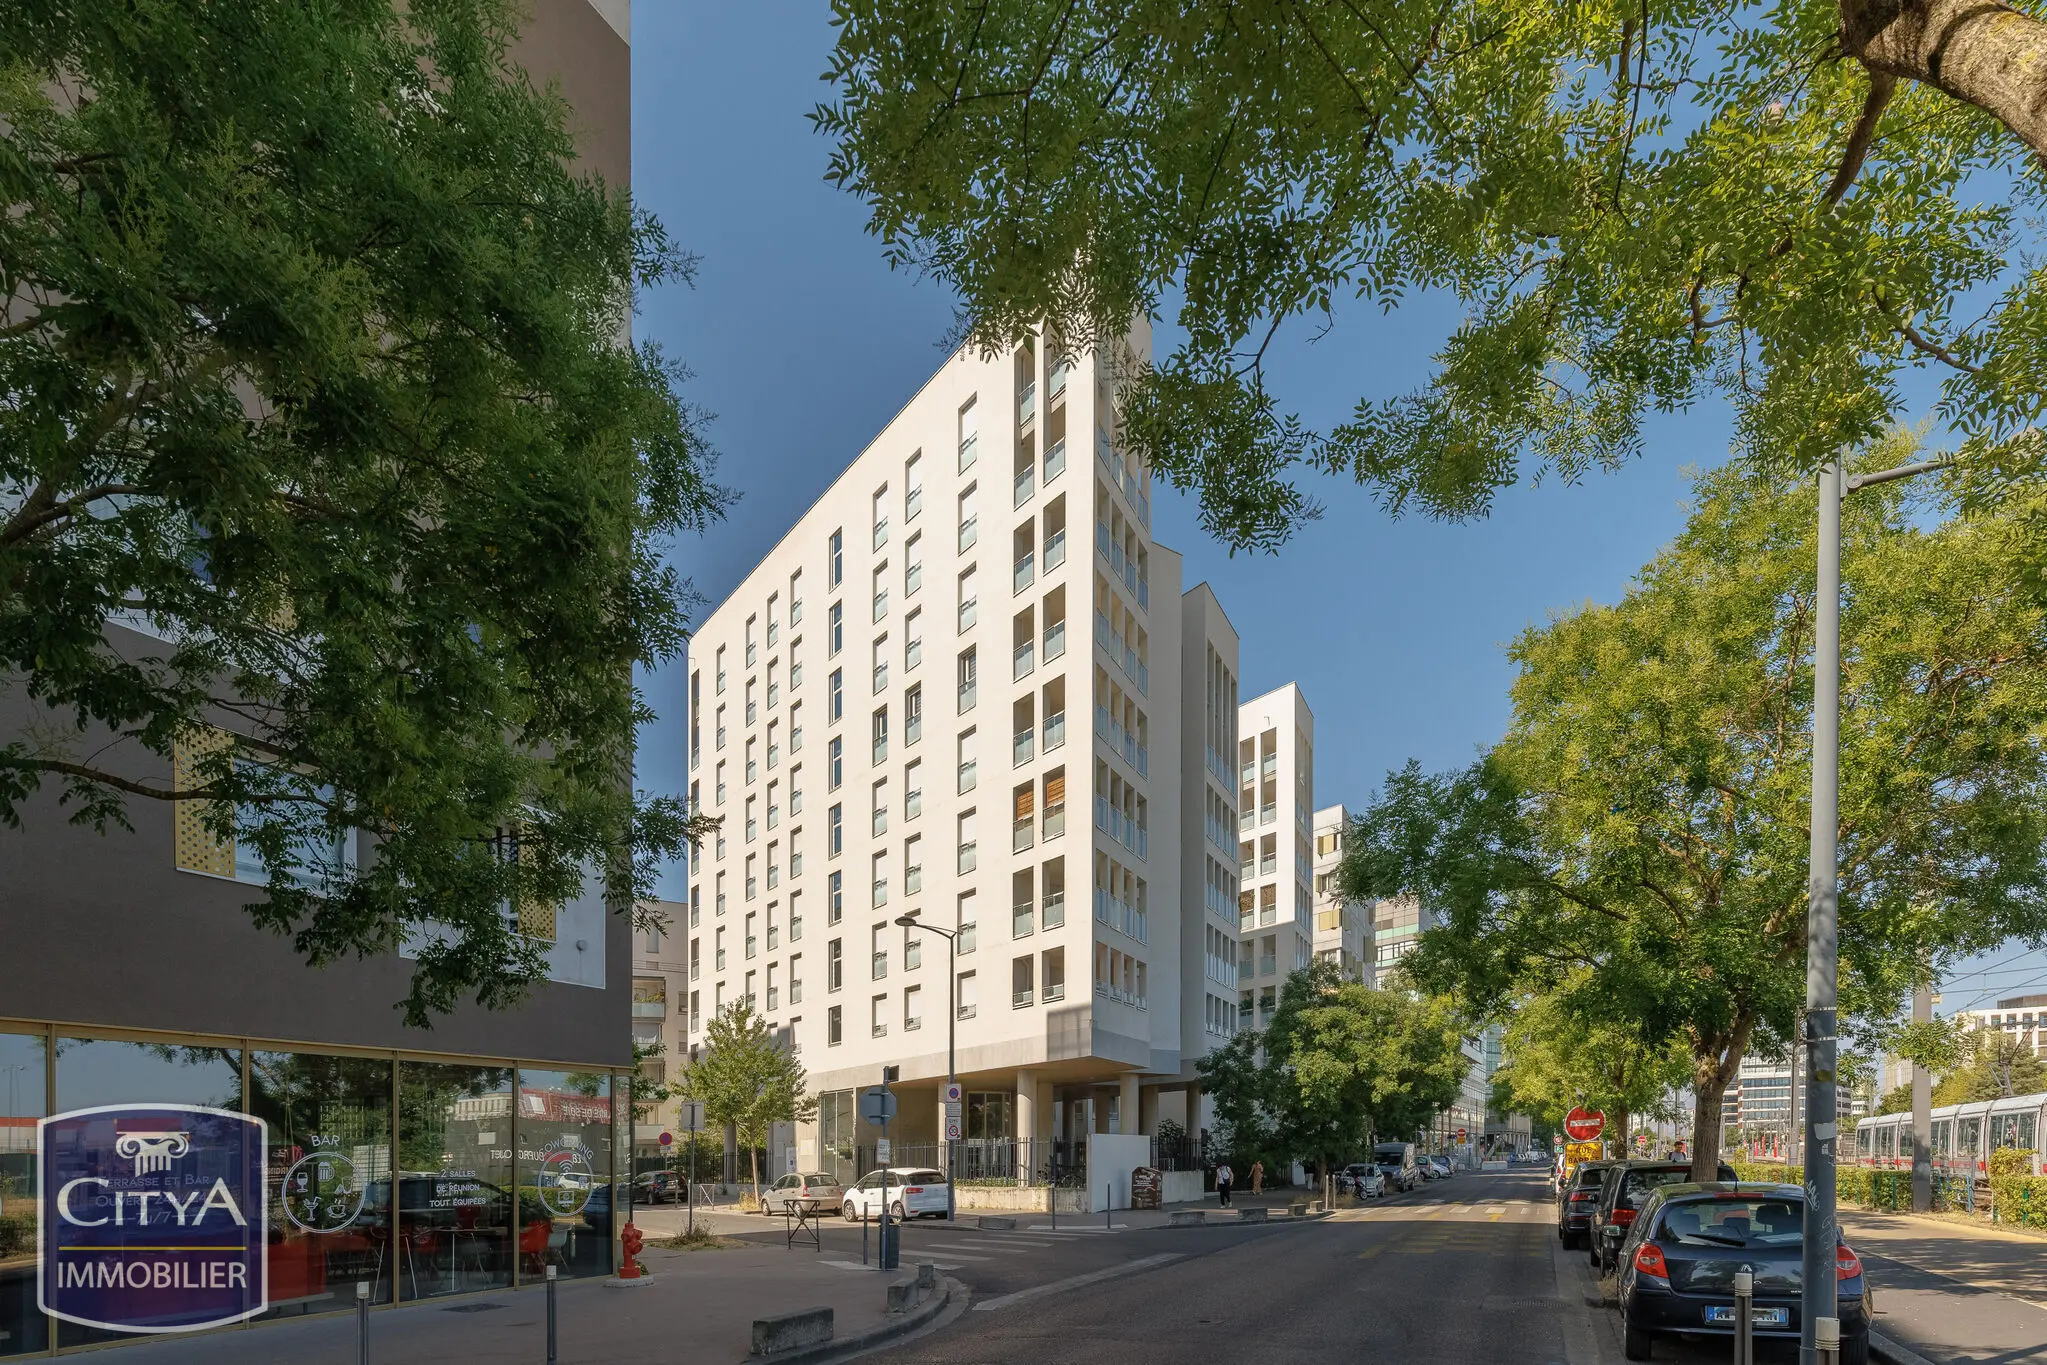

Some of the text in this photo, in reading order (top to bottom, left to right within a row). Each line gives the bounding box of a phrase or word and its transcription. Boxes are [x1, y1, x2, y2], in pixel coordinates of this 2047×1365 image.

[311, 1135, 340, 1146] BAR
[440, 1168, 476, 1178] 2 SALLES
[436, 1183, 446, 1192] DE
[429, 1199, 451, 1207] TOUT
